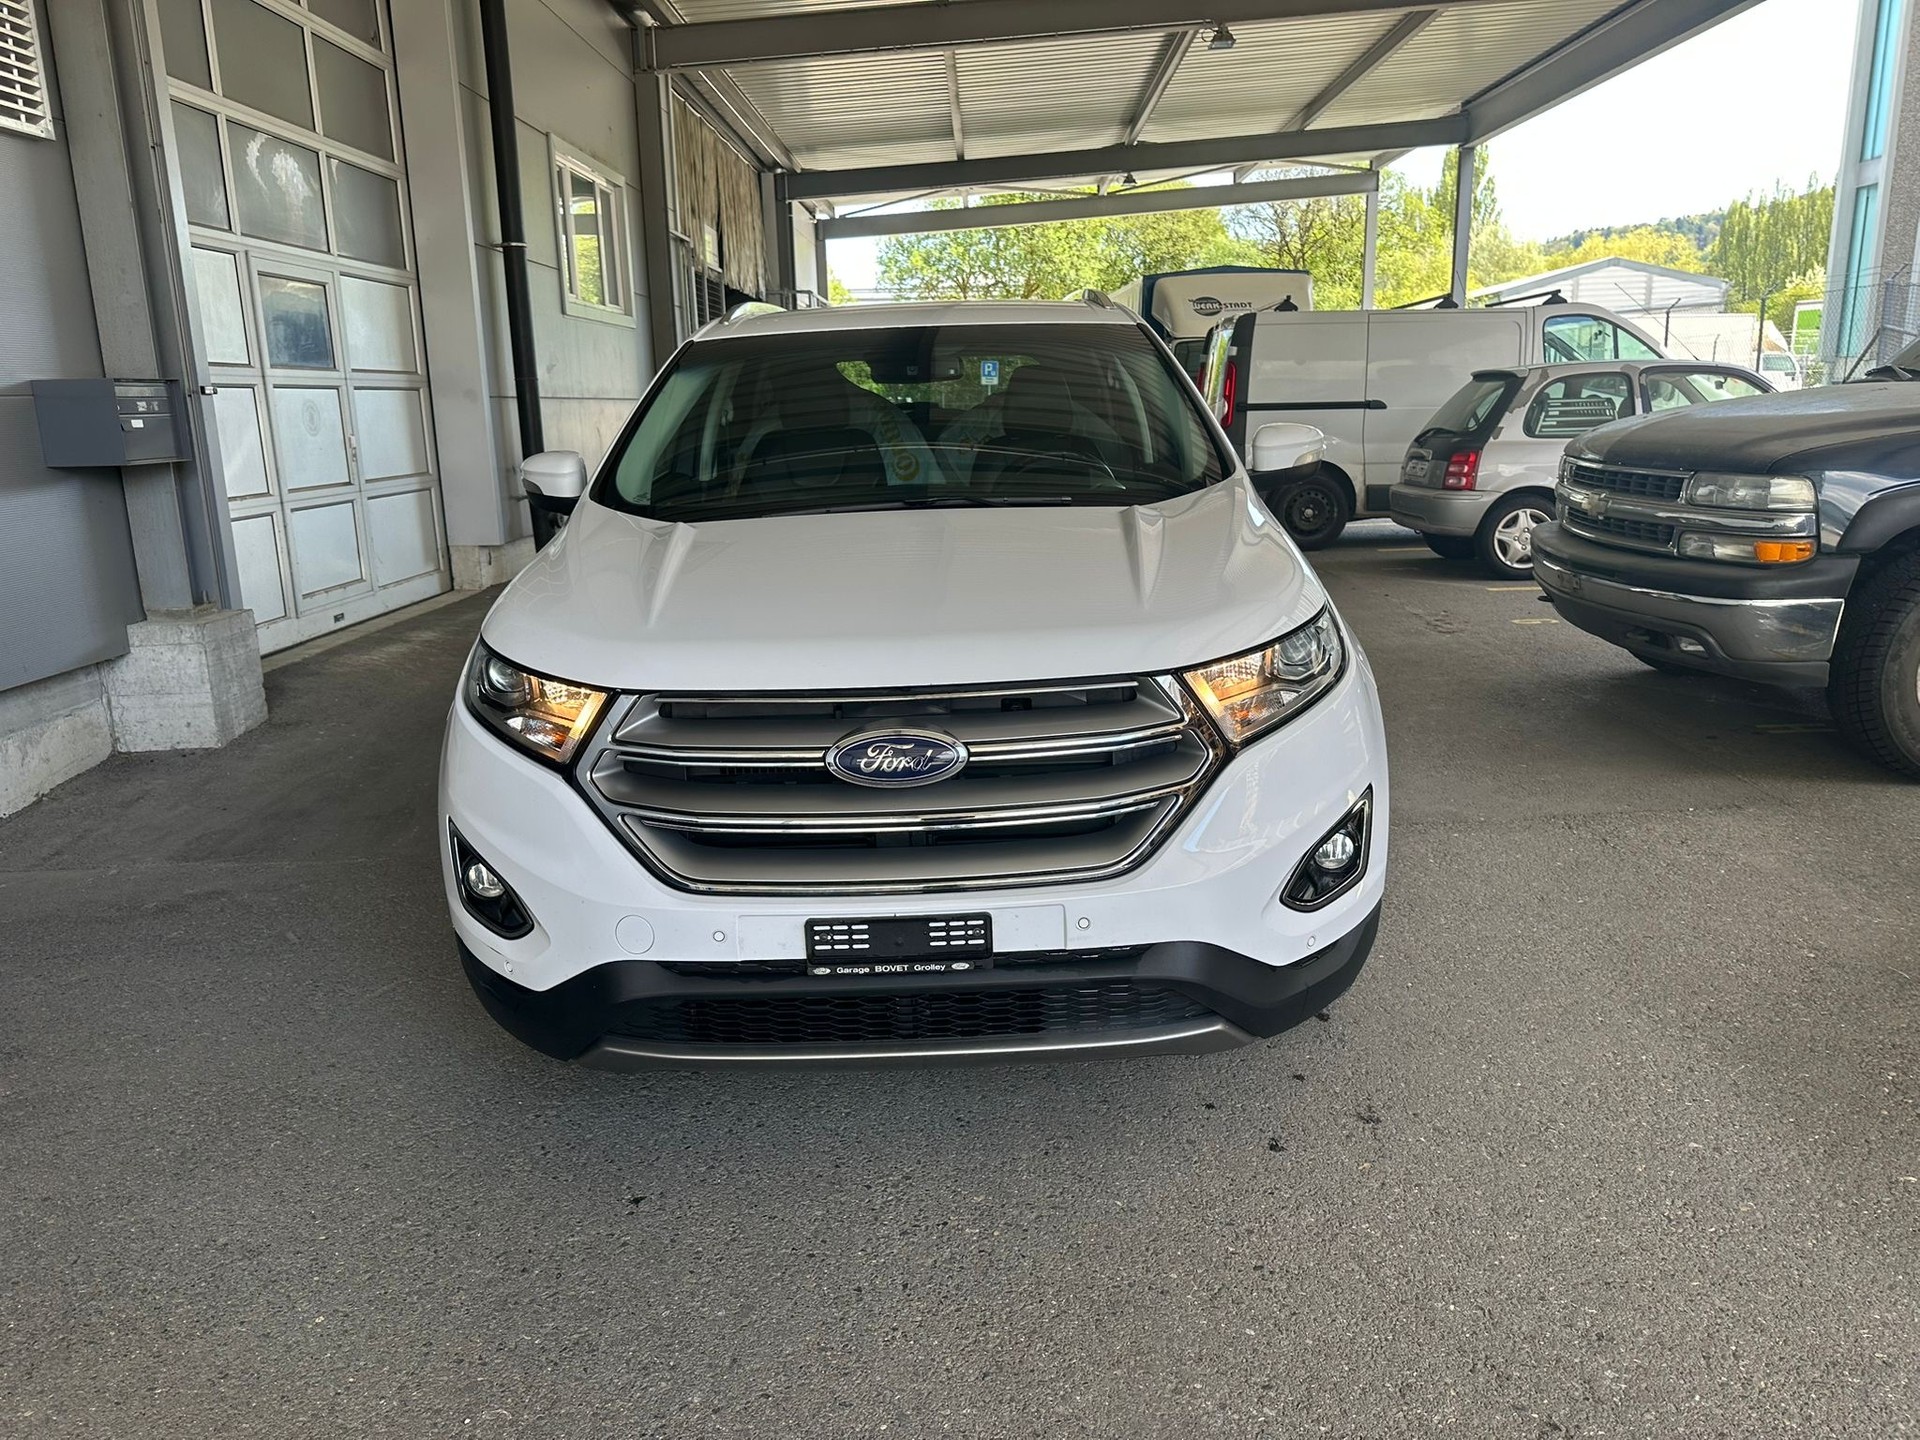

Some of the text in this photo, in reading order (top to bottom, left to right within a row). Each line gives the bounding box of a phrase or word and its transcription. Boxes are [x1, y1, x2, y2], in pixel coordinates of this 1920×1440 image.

[984, 363, 993, 375] P
[859, 743, 933, 773] Ford
[836, 966, 870, 975] Garage
[874, 964, 909, 973] BOVET
[913, 963, 946, 971] Grolley
